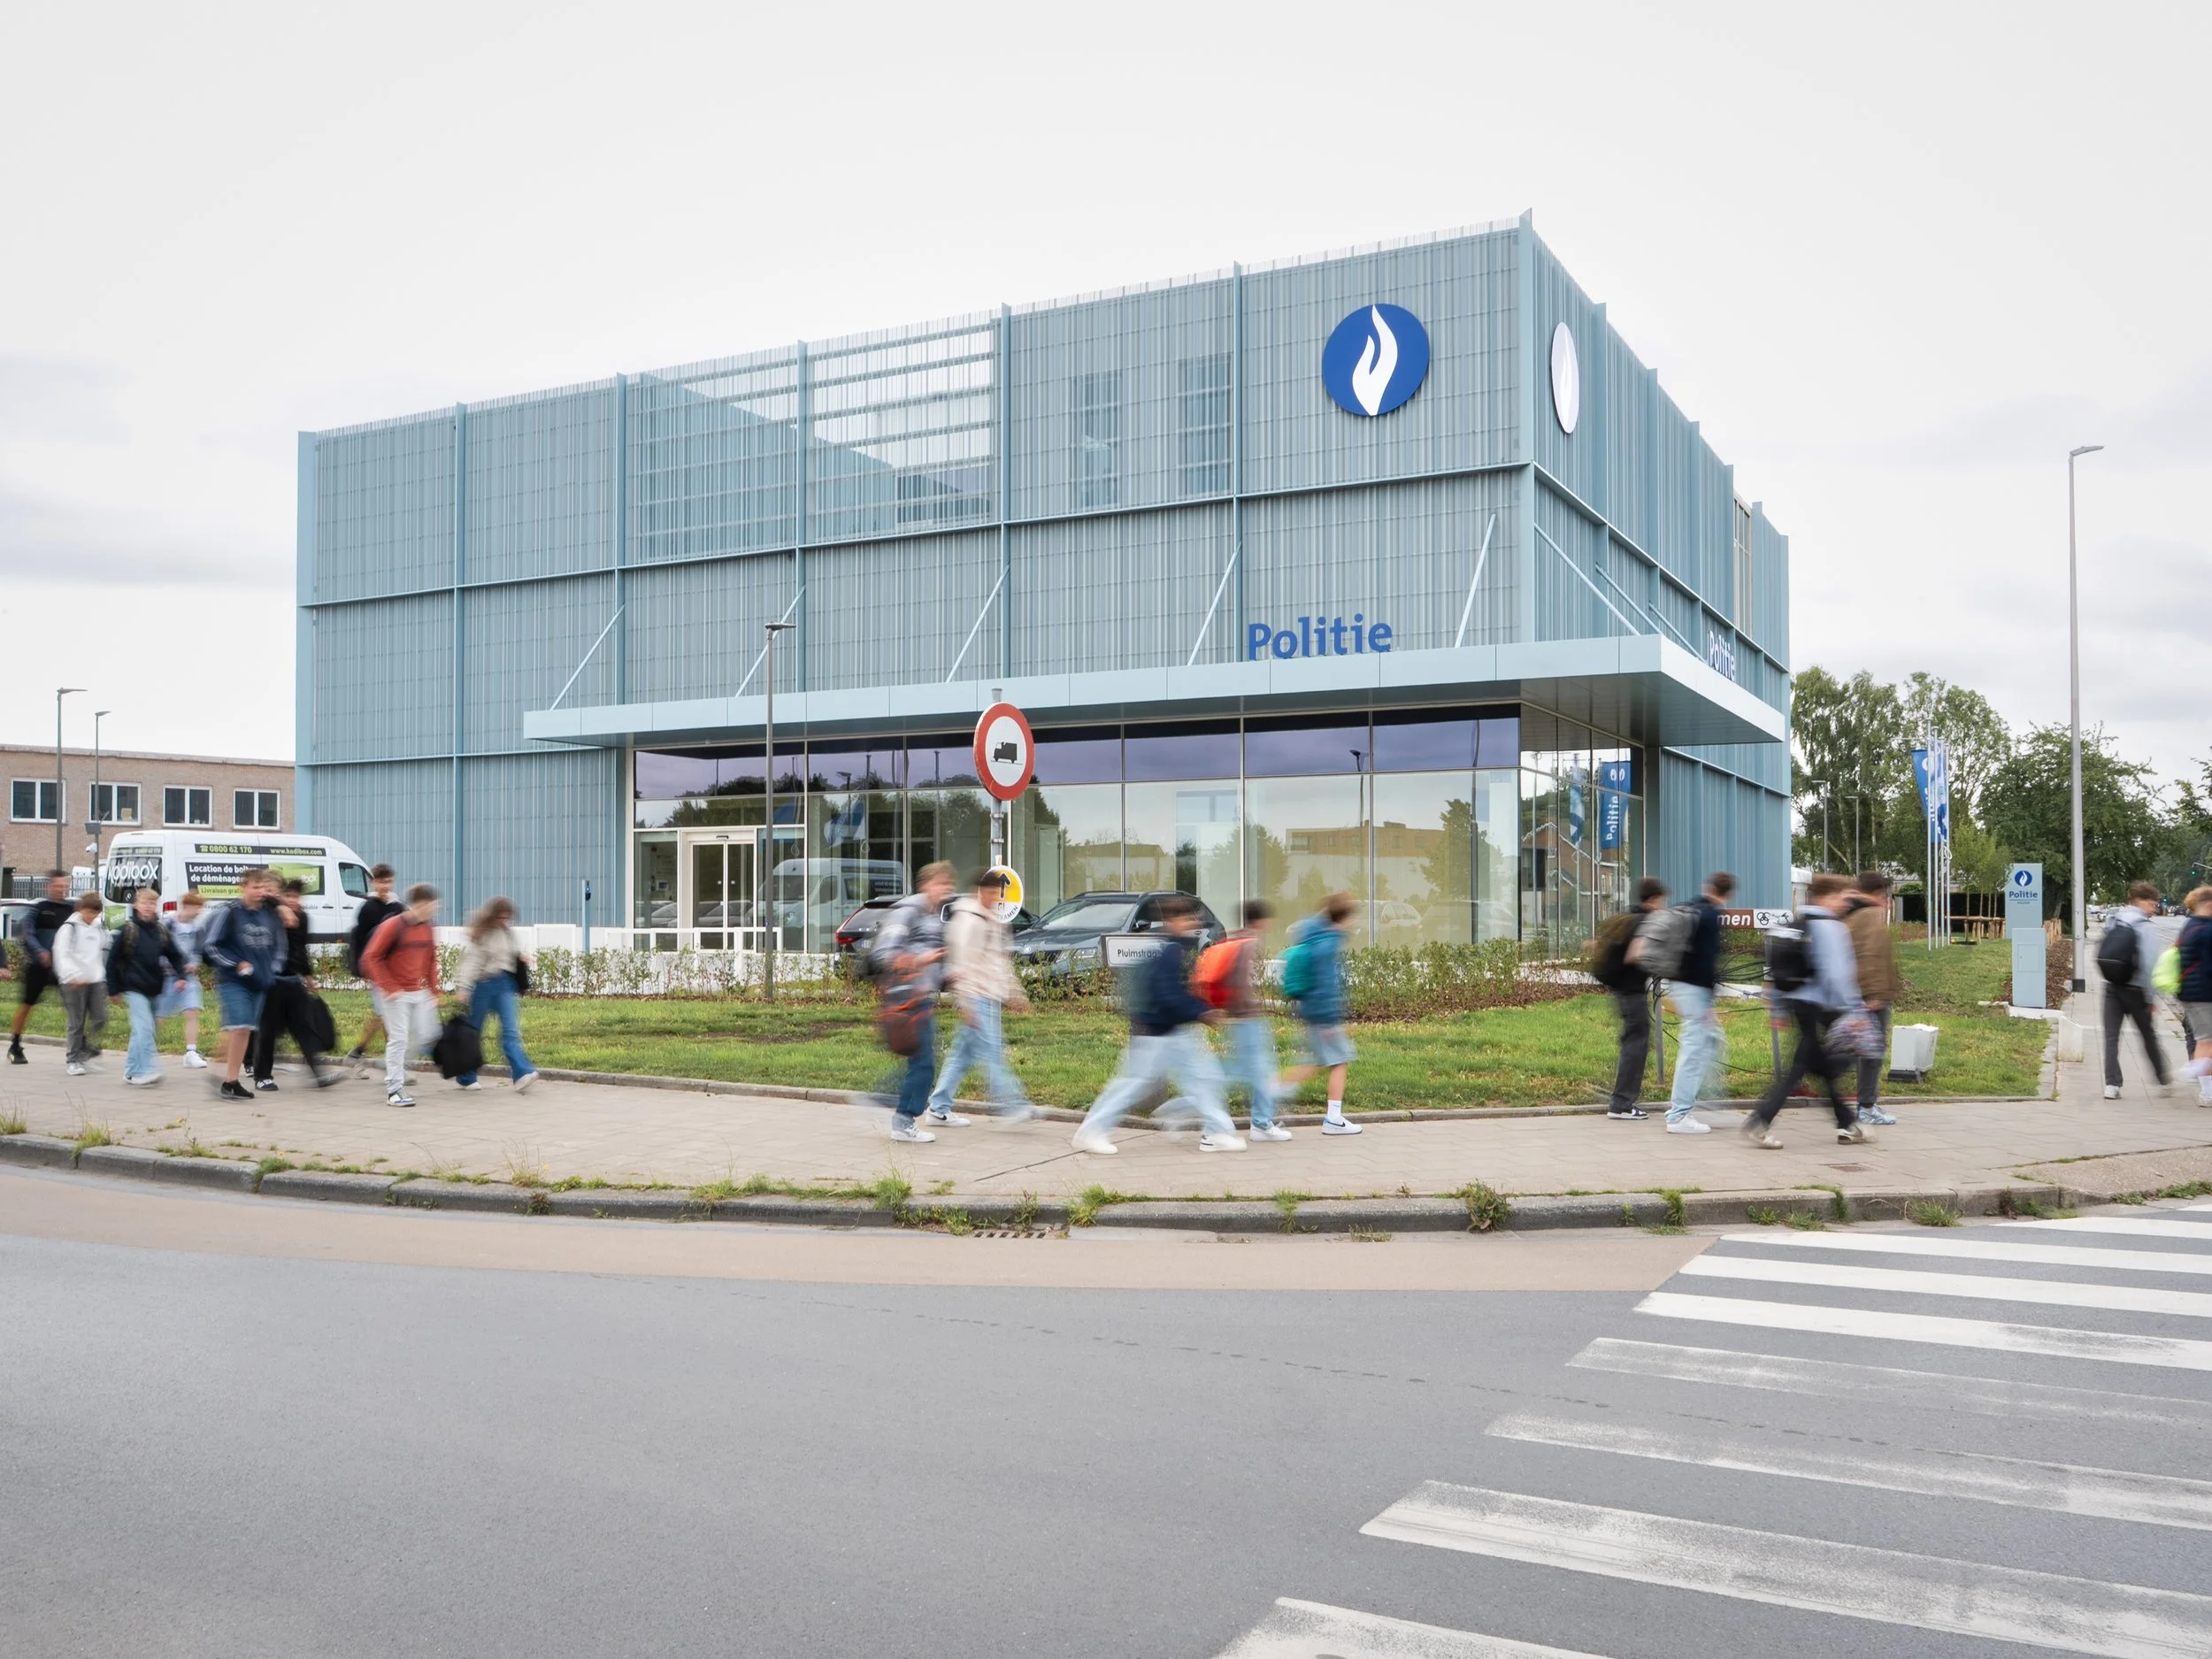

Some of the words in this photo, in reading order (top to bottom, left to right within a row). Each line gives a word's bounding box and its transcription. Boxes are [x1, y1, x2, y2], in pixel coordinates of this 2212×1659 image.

[1248, 613, 1393, 661] Politie
[1709, 630, 1735, 681] Politie
[188, 864, 223, 873] Location
[223, 864, 234, 873] de
[190, 873, 201, 882] de
[202, 873, 244, 884] déménage
[2008, 890, 2039, 899] Politie
[1717, 913, 1751, 926] men
[1117, 949, 1158, 958] Pluimstraa
